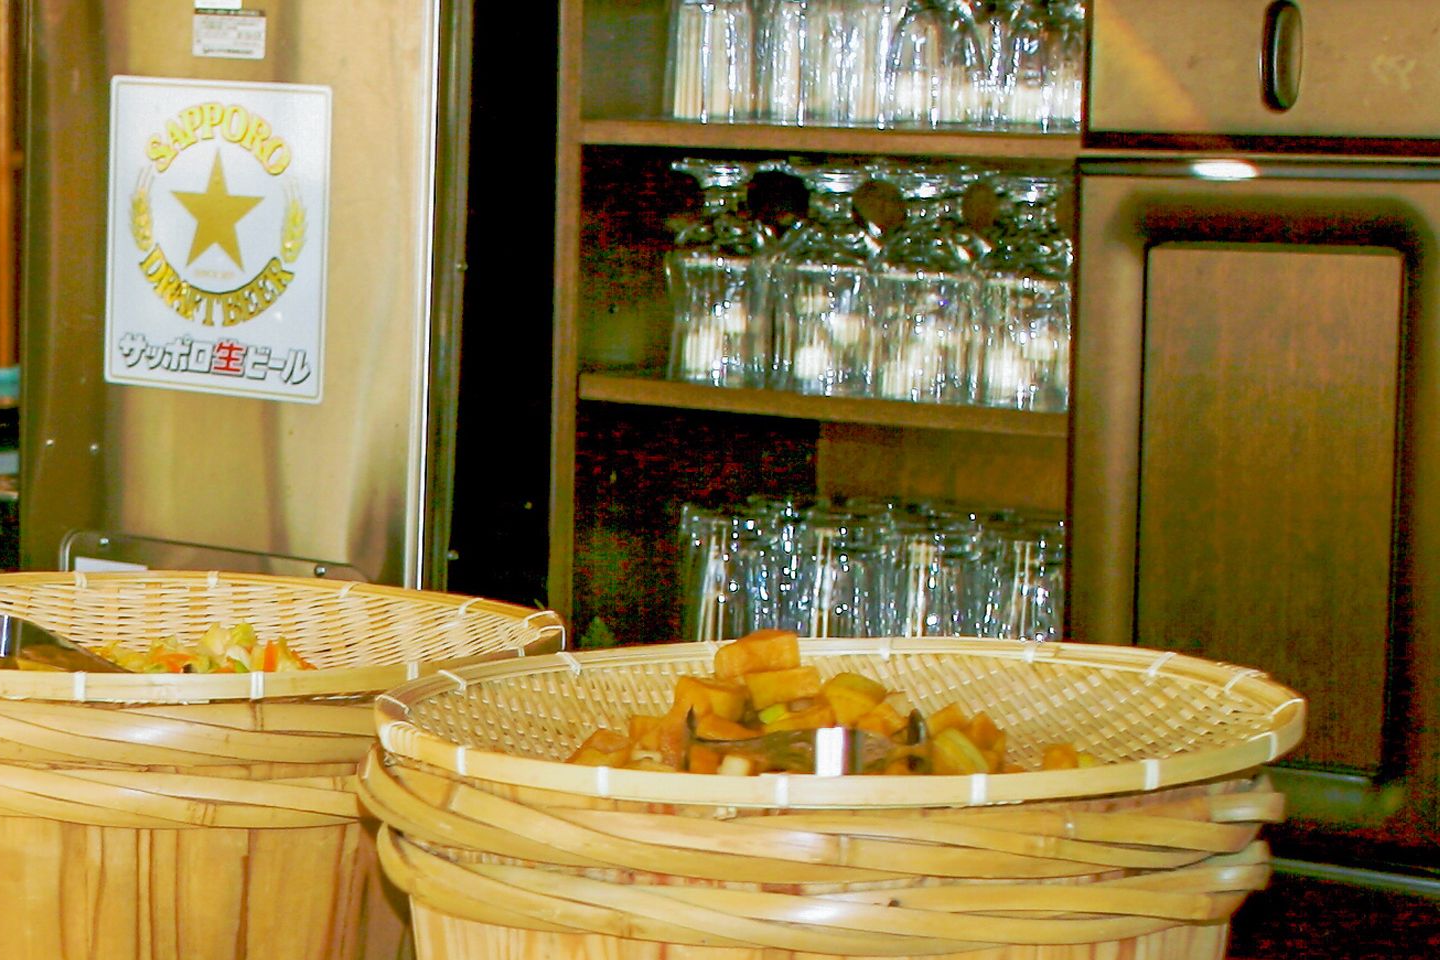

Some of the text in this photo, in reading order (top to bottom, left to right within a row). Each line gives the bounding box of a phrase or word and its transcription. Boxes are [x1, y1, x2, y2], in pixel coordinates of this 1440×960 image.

[146, 103, 292, 176] SAPPORO
[139, 243, 296, 327] DRAFT BEER
[118, 332, 312, 385] サッポロ生ビール
